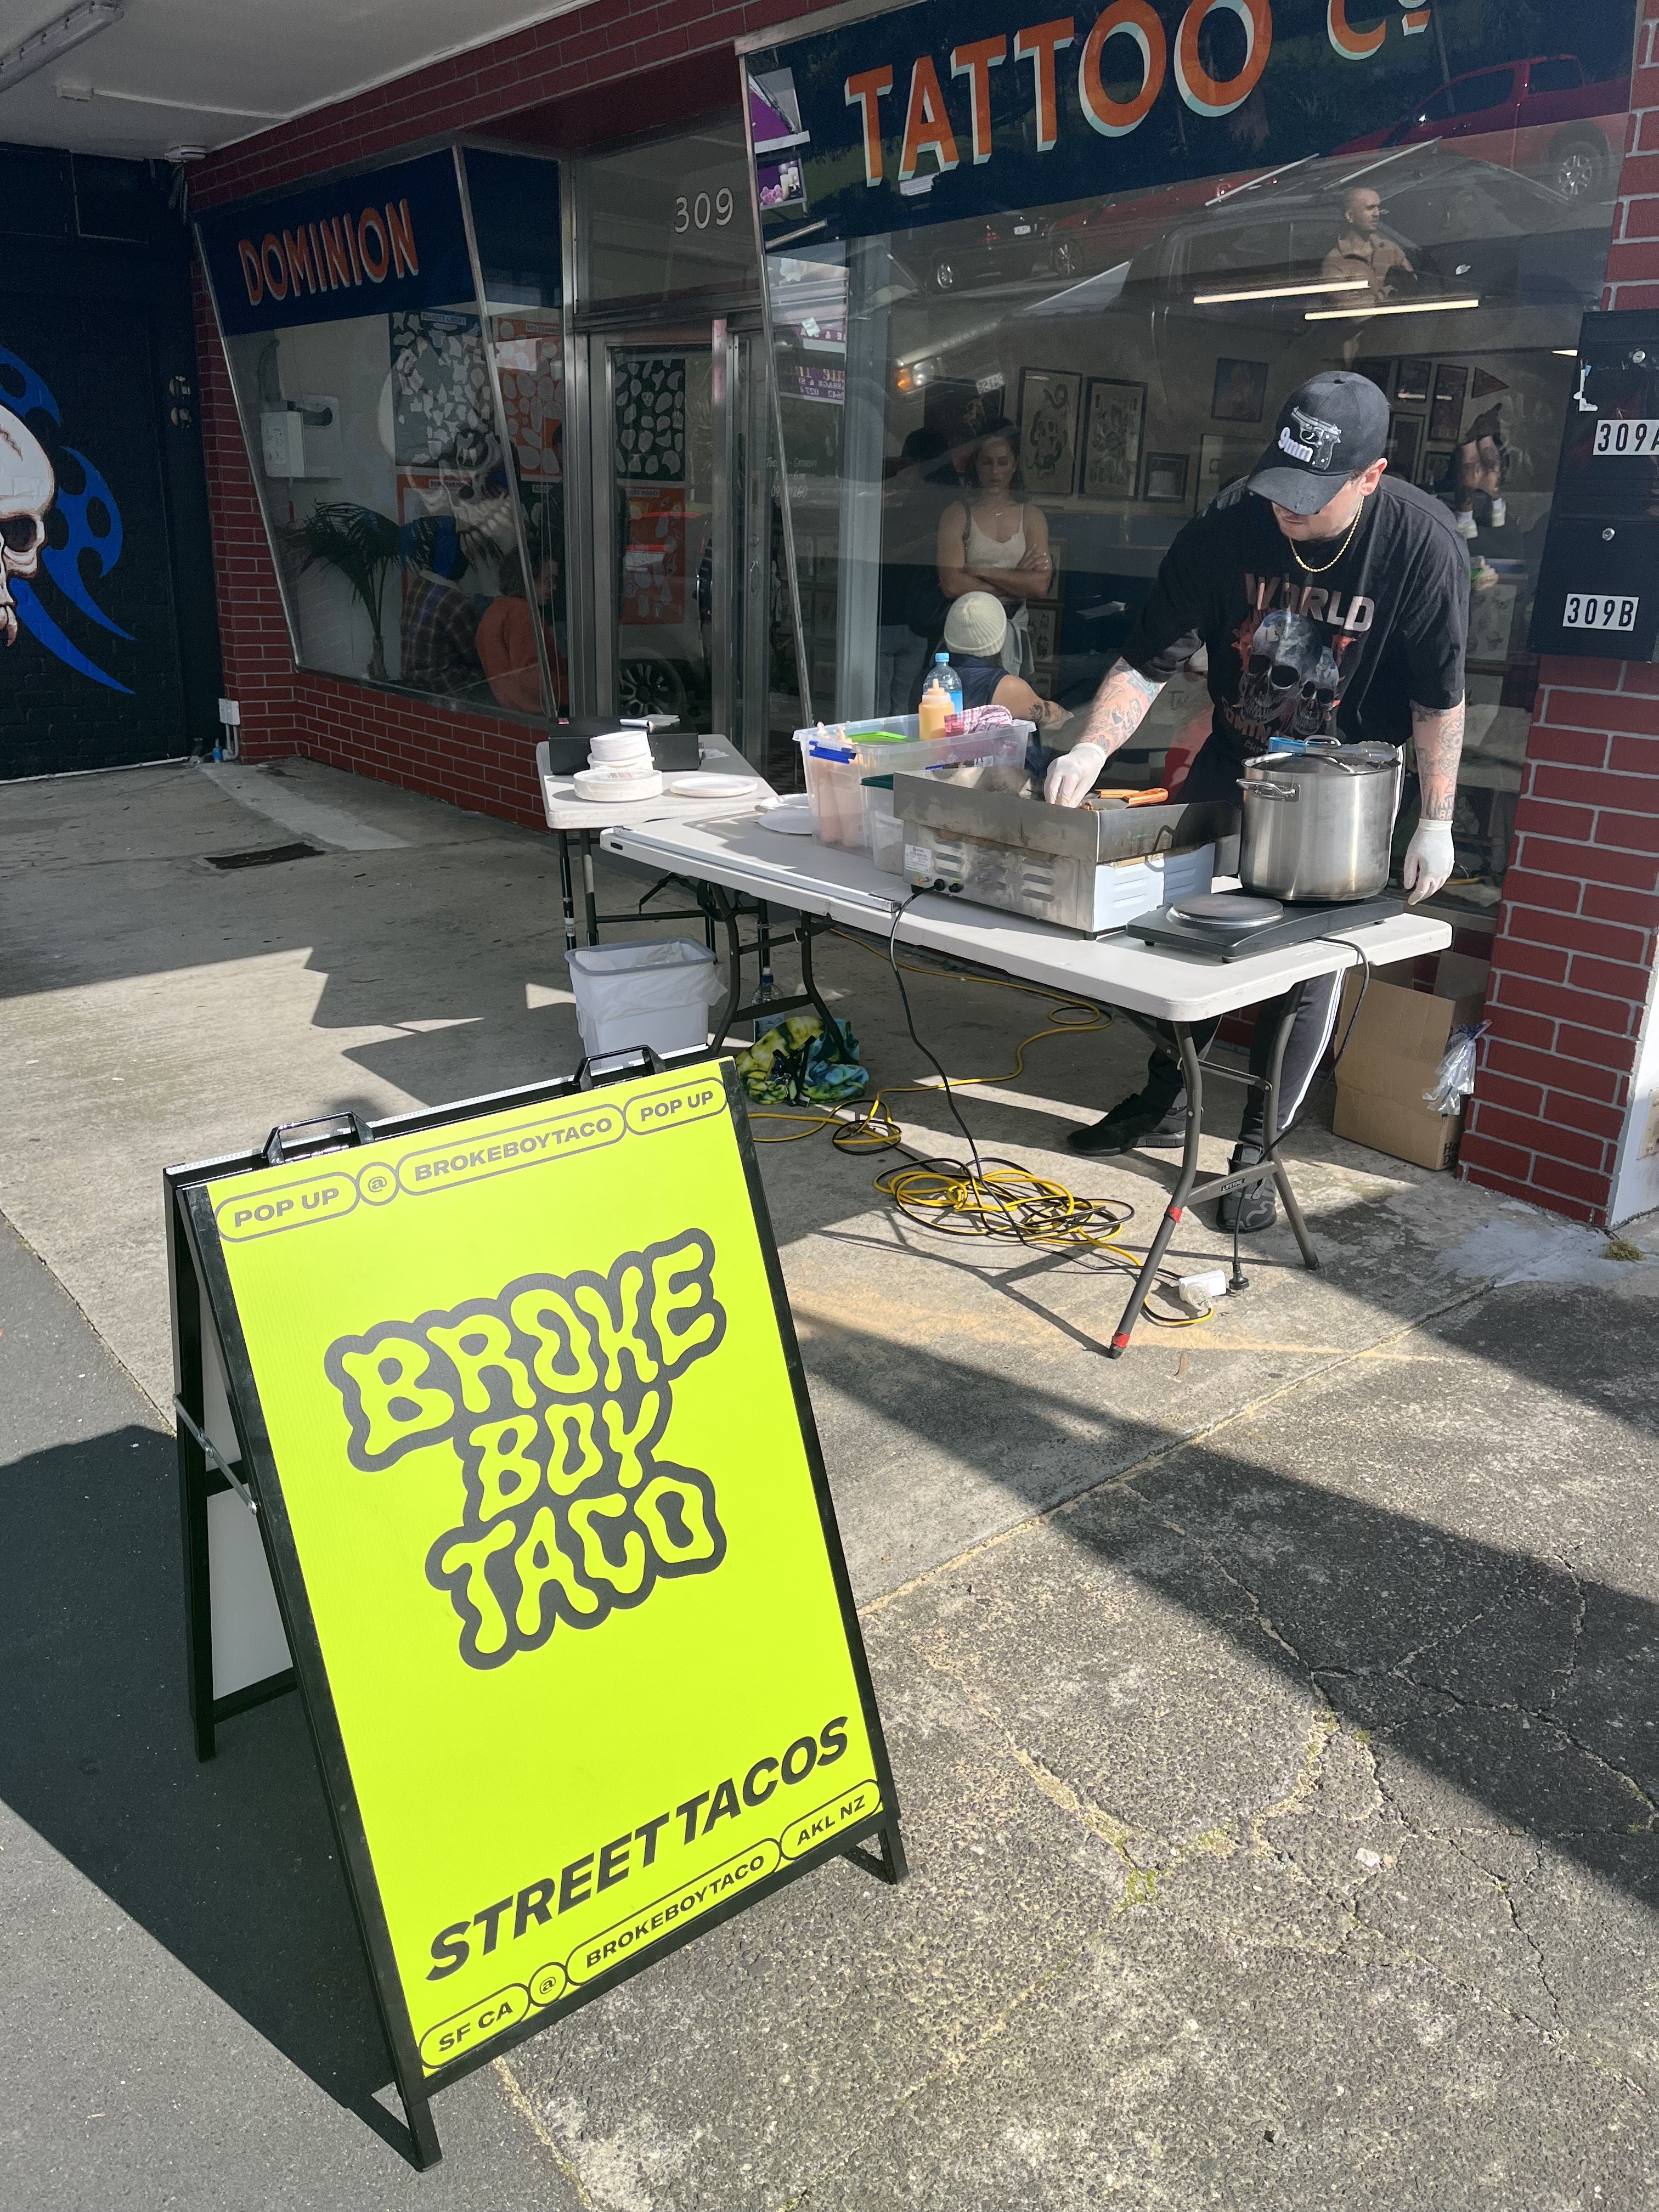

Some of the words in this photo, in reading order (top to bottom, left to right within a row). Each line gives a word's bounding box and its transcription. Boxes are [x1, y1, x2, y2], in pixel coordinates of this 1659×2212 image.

[844, 0, 1273, 188] TATTOO
[674, 187, 733, 234] 309
[238, 198, 419, 306] DOMINION
[1278, 426, 1313, 462] 9mm
[1245, 572, 1375, 631] WORLD
[1567, 597, 1634, 627] 309B
[640, 1098, 683, 1123] POP
[686, 1091, 714, 1110] UP
[414, 1118, 613, 1183] BROKEBOYTACO
[233, 1199, 295, 1229] POP
[301, 1187, 340, 1211] UP
[366, 1176, 388, 1194] @
[325, 1229, 725, 1470] BROKE
[460, 1384, 667, 1526] BOY
[427, 1462, 725, 1668] TACO
[797, 1815, 836, 1846] AKL
[840, 1796, 866, 1819] NZ
[426, 1812, 670, 1982] STREET
[675, 1716, 849, 1845] TACOS
[586, 1855, 764, 1968] BROKEBOYTACO
[539, 1976, 556, 1995] @
[439, 2026, 471, 2052] SF
[478, 2002, 514, 2029] CA
